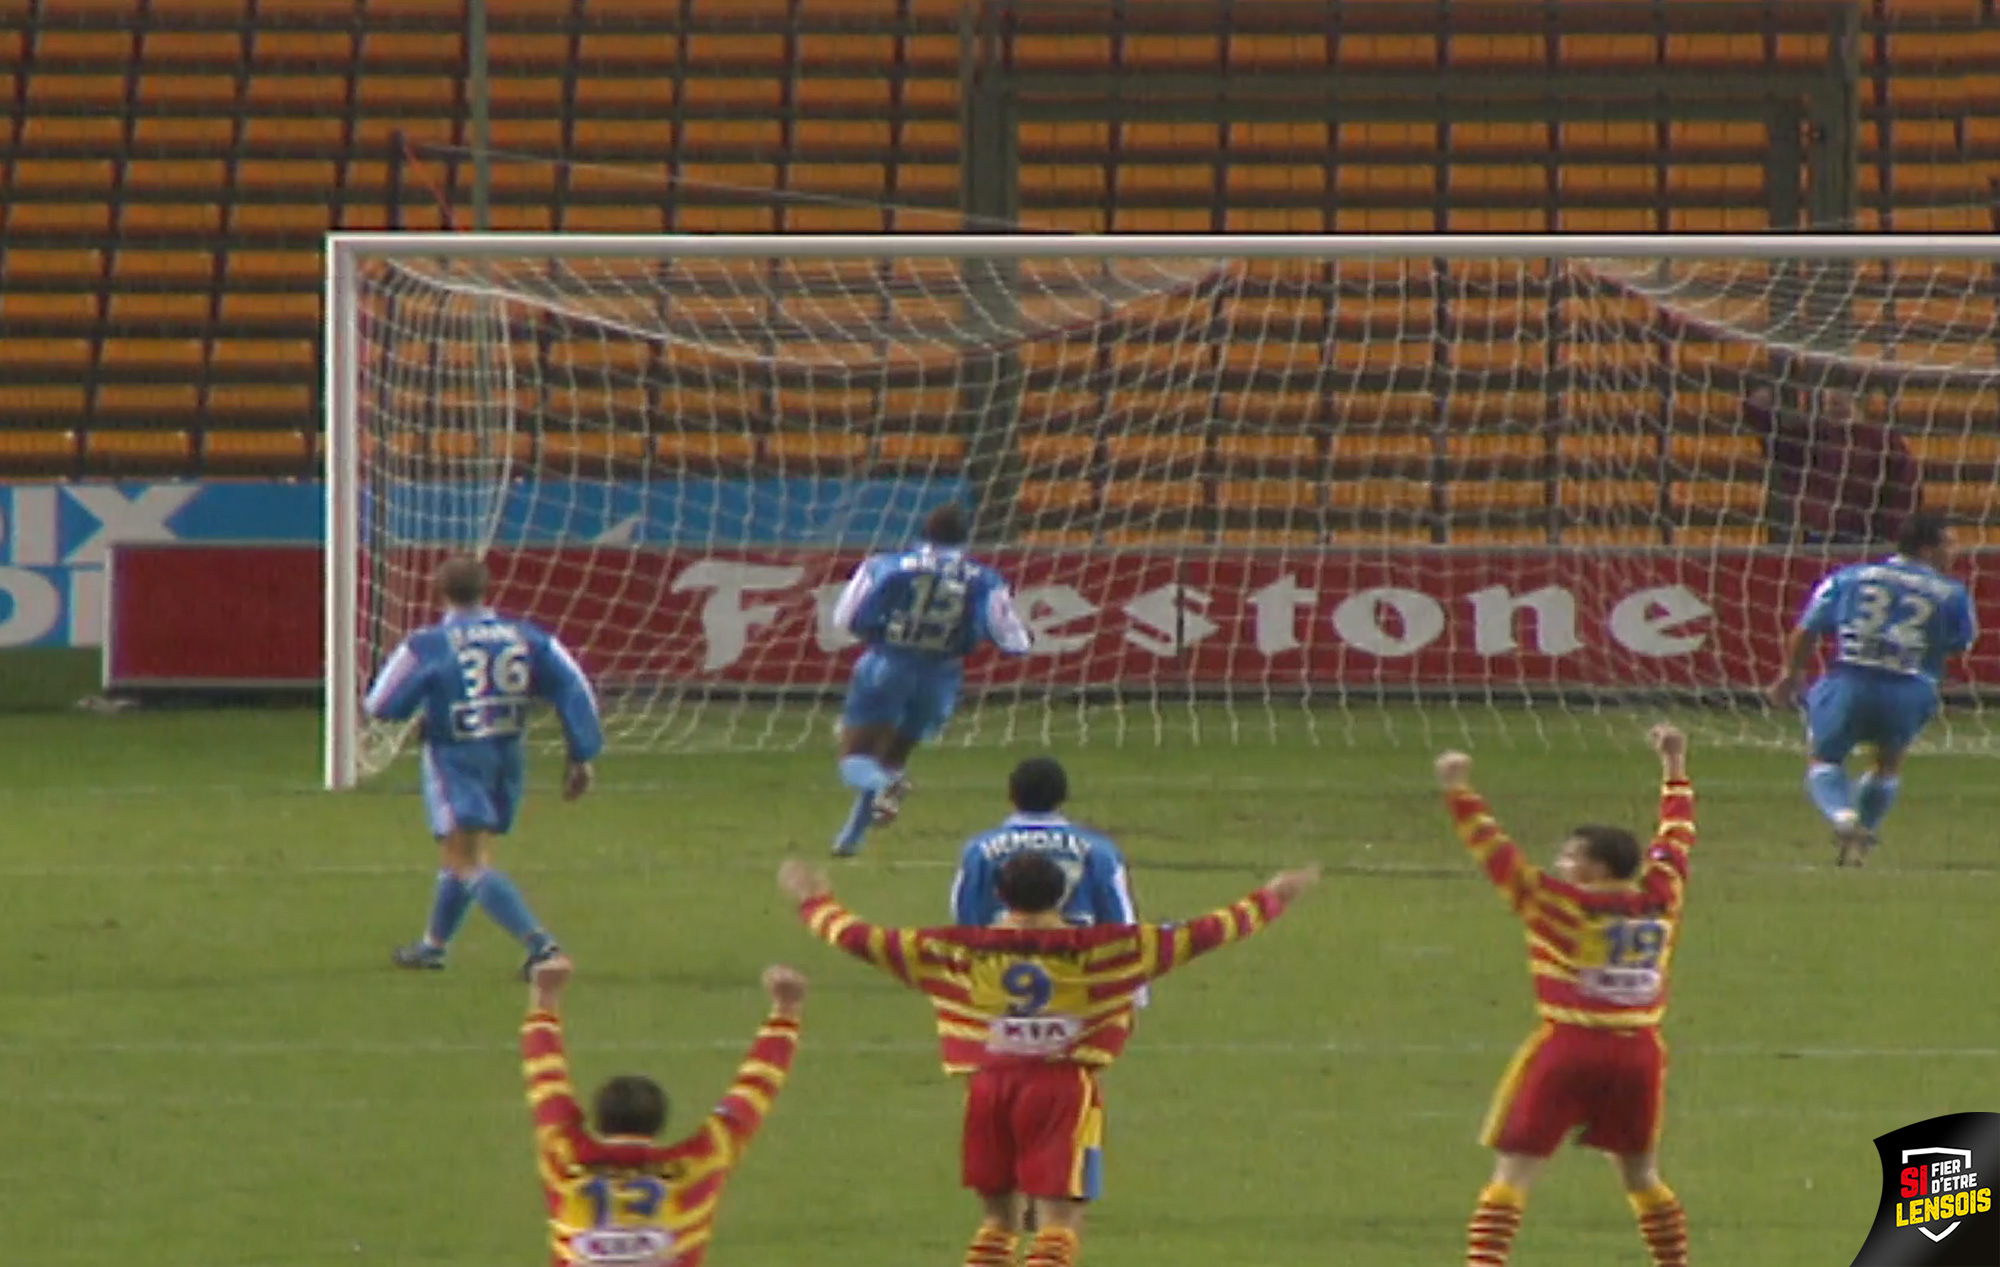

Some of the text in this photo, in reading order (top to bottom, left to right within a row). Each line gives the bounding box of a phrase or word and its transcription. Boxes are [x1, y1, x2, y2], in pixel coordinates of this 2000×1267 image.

[1855, 583, 1934, 647] 32
[457, 644, 531, 696] 36
[1604, 921, 1664, 969] 19
[1002, 962, 1055, 1019] 9
[1004, 1022, 1067, 1040] KIA
